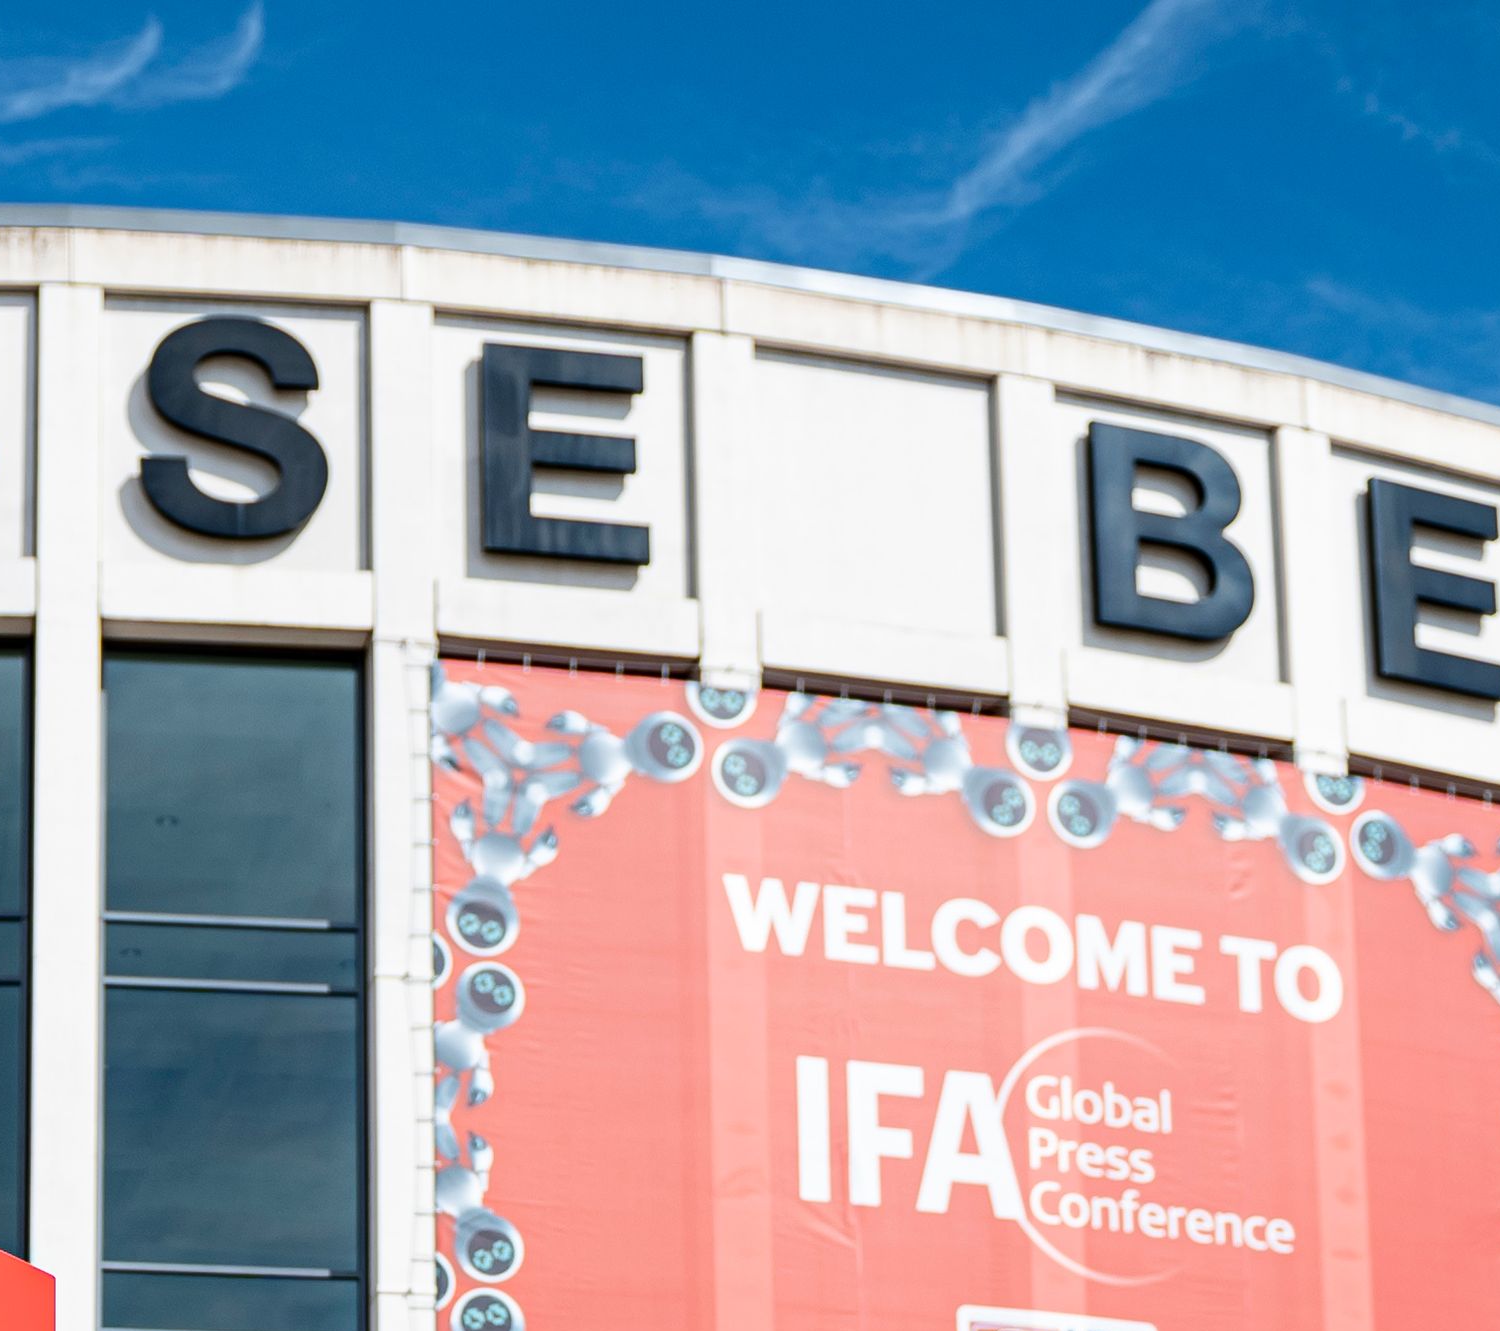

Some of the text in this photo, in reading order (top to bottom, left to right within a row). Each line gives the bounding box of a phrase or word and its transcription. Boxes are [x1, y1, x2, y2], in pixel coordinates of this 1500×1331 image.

[721, 872, 1345, 1024] WELCOME TO
[796, 1055, 1025, 1220] IFA
[1025, 1075, 1173, 1134] Global
[1028, 1127, 1155, 1184] Press
[1029, 1180, 1296, 1254] Conference
